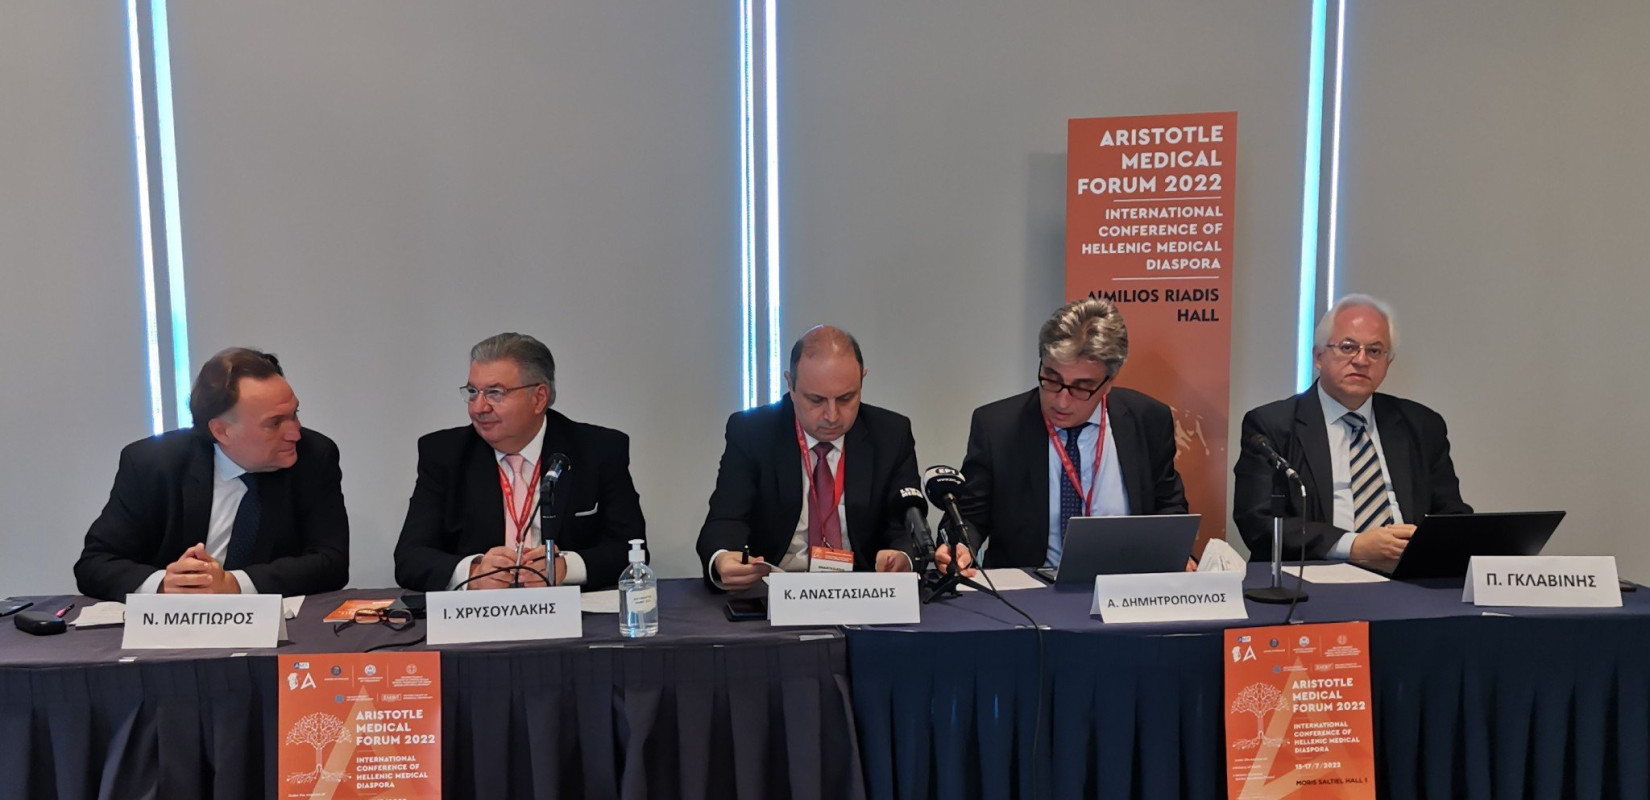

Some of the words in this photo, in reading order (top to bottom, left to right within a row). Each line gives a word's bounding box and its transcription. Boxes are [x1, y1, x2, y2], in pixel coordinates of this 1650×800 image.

[1099, 125, 1223, 147] ARISTOTLE
[1121, 149, 1223, 170] MEDICAL
[1077, 176, 1157, 195] FORUM
[1164, 173, 1222, 192] 2022
[1105, 206, 1223, 220] INTERNATIONAL
[1098, 223, 1197, 237] CONFERENCE
[1202, 223, 1223, 235] OF
[1081, 242, 1152, 255] HELLENIC
[1156, 241, 1222, 253] MEDICAL
[1146, 258, 1221, 271] DIASPORA
[1165, 288, 1219, 302] RIADIS
[1177, 309, 1219, 322] HALL
[1486, 573, 1502, 586] Π.
[1507, 573, 1597, 588] ΓΚΛΑΒΙΝΗΣ
[784, 589, 796, 600] Κ.
[799, 587, 896, 600] ΑΝΑΣΤΑΣΙΑΔΗΣ
[1107, 599, 1119, 608] Α.
[1122, 593, 1227, 608] ΔΗΜΗΤΡΟΠΟΥΛΟΣ
[443, 608, 452, 620] Ι.
[455, 603, 557, 620] ΧΡΥΣΟΥΛΑΚΗΣ
[143, 612, 159, 626] Ν.
[164, 612, 254, 625] ΜΑΓΓΙΩΡΟΣ
[1292, 677, 1354, 689] ARISTOTLE
[1292, 690, 1343, 701] MEDICAL
[1293, 702, 1333, 713] FORUM
[1336, 701, 1366, 711] 2022
[356, 709, 423, 720] ARISTOTLE
[356, 722, 412, 733] MEDICAL
[1293, 721, 1348, 729] INTERNATIONAL
[1293, 729, 1340, 737] CONFERENCE
[356, 735, 400, 746] FORUM
[404, 734, 436, 744] 2022
[1294, 738, 1328, 746] HELLENIC
[356, 755, 416, 763] INTERNATIONAL
[356, 763, 407, 772] CONFERENCE
[356, 781, 395, 789] DIASPORA
